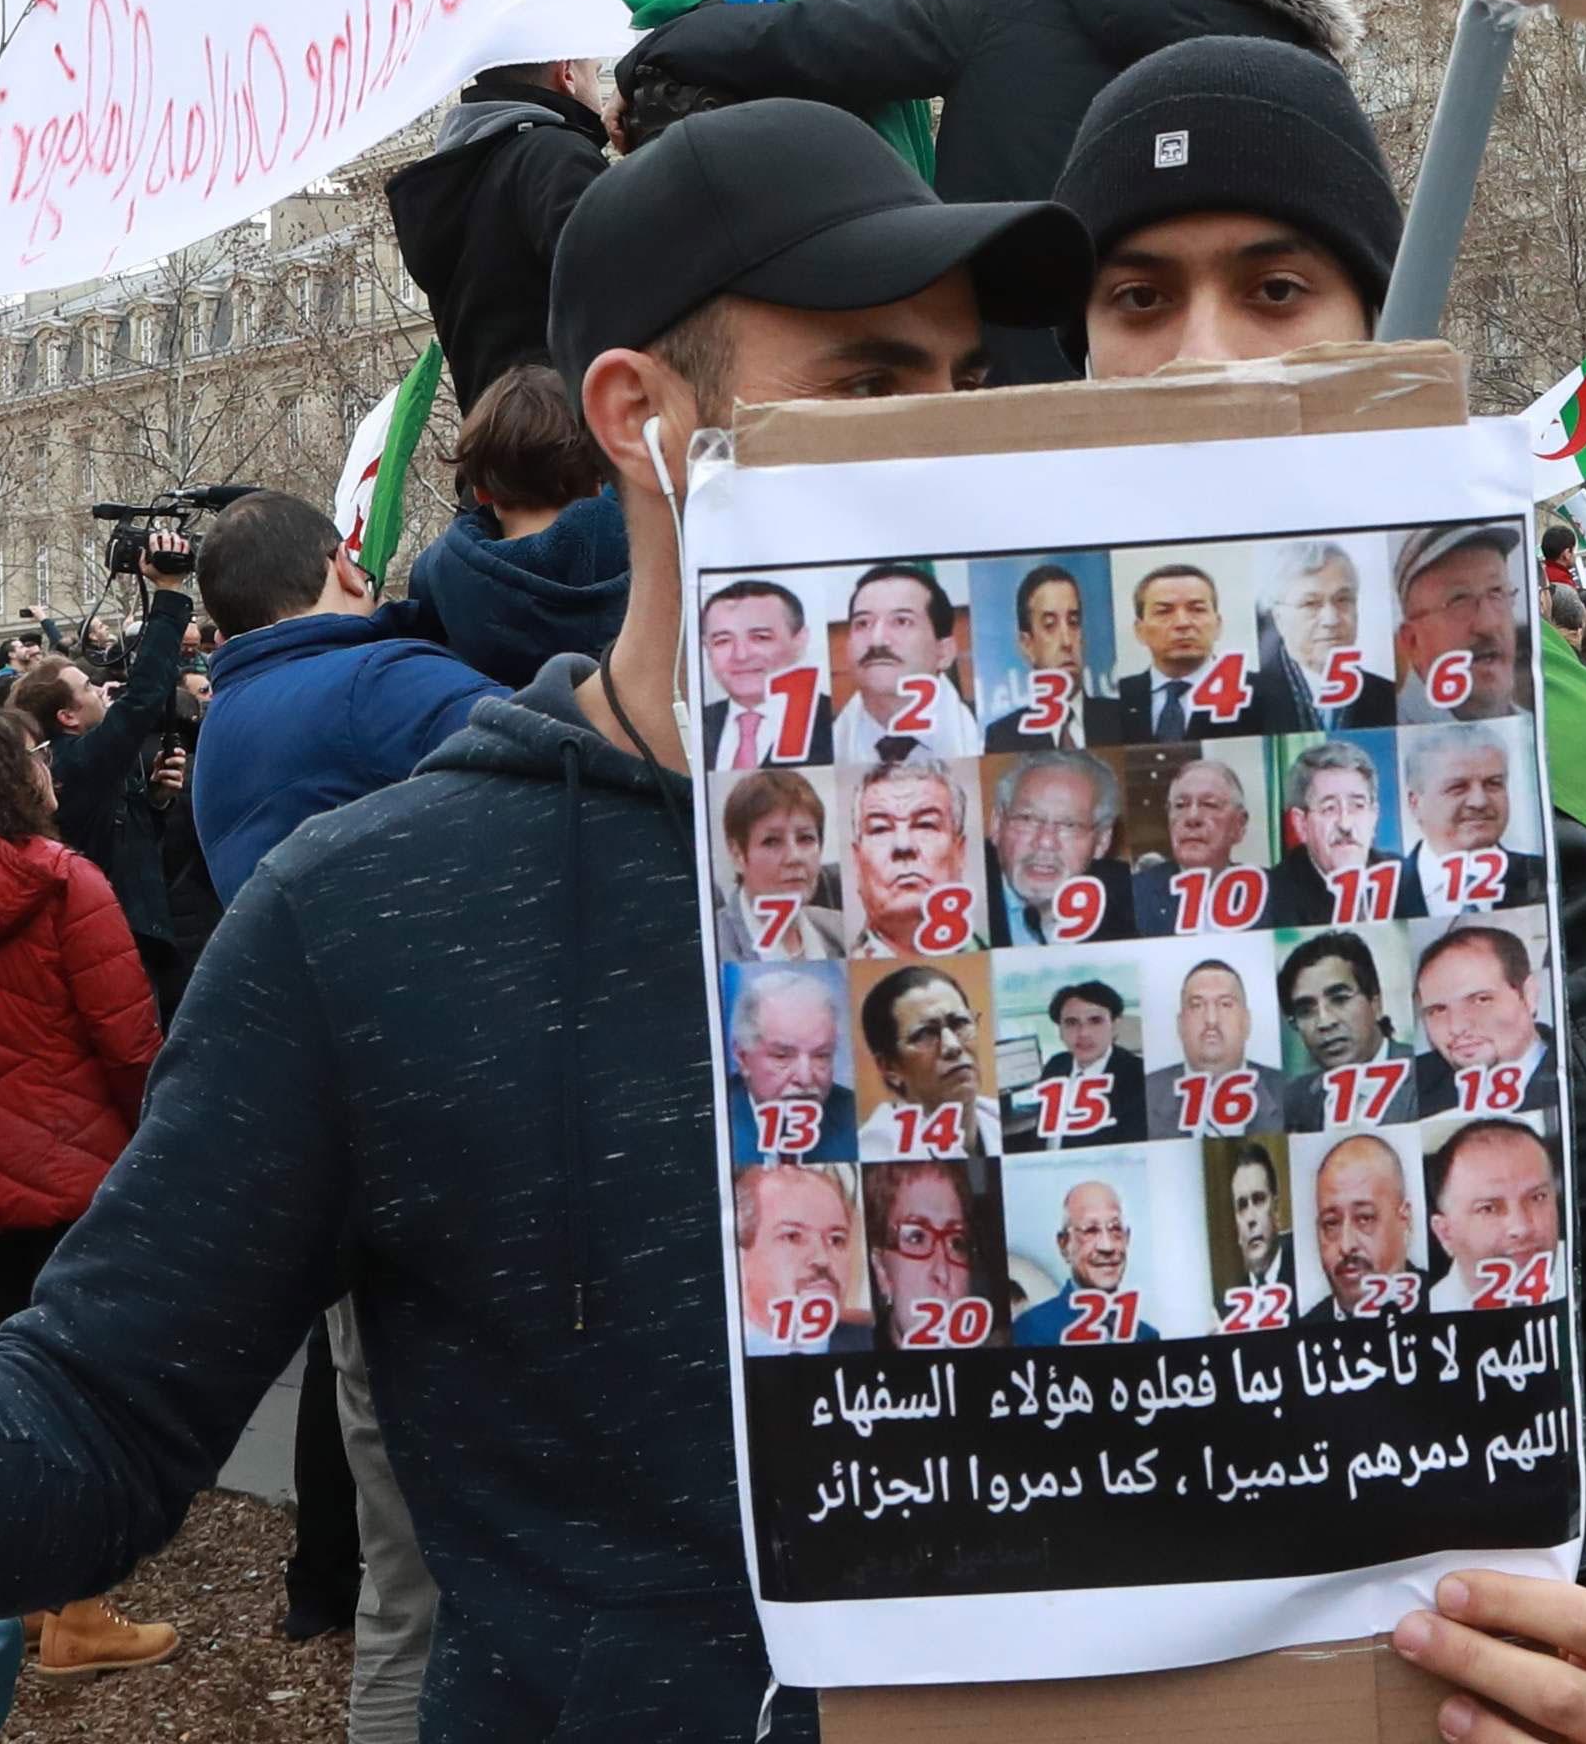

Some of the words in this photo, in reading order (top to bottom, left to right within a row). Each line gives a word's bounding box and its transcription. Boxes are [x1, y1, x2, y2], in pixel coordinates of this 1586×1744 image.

[766, 669, 821, 760] 1
[893, 681, 935, 731] 2
[1023, 673, 1068, 729] 3
[1195, 655, 1250, 720] 4
[1321, 653, 1360, 704] 5
[1432, 653, 1469, 704] 6
[756, 899, 796, 949] 7
[920, 890, 969, 949] 8
[1057, 880, 1102, 936] 9
[1174, 870, 1265, 931] 10
[1334, 868, 1399, 923] 11
[1443, 855, 1504, 903] 12
[760, 1105, 817, 1150] 13
[895, 1106, 959, 1152] 14
[1039, 1078, 1109, 1133] 15
[1178, 1074, 1253, 1127] 16
[1330, 1062, 1408, 1123] 17
[1461, 1068, 1520, 1109] 18
[771, 1296, 832, 1342] 19
[911, 1301, 989, 1344] 20
[1064, 1295, 1136, 1342] 21
[1227, 1287, 1285, 1330] 22
[1360, 1275, 1416, 1314] 23
[1478, 1257, 1551, 1306] 24
[1110, 1353, 1217, 1427] فعلوه
[1232, 1348, 1283, 1418] بما
[1297, 1312, 1417, 1396] تأخذنا
[1431, 1323, 1461, 1383] لا
[1477, 1314, 1559, 1402] اللهم
[812, 1362, 956, 1438] السفهاء
[990, 1359, 1094, 1430] هؤلاء
[1098, 1447, 1160, 1495] كما
[1203, 1440, 1330, 1503] تدميرا
[1347, 1433, 1470, 1501] دمرهم
[1485, 1406, 1569, 1484] اللهم
[808, 1455, 950, 1522] الجزائر
[969, 1454, 1083, 1514] دمروا
